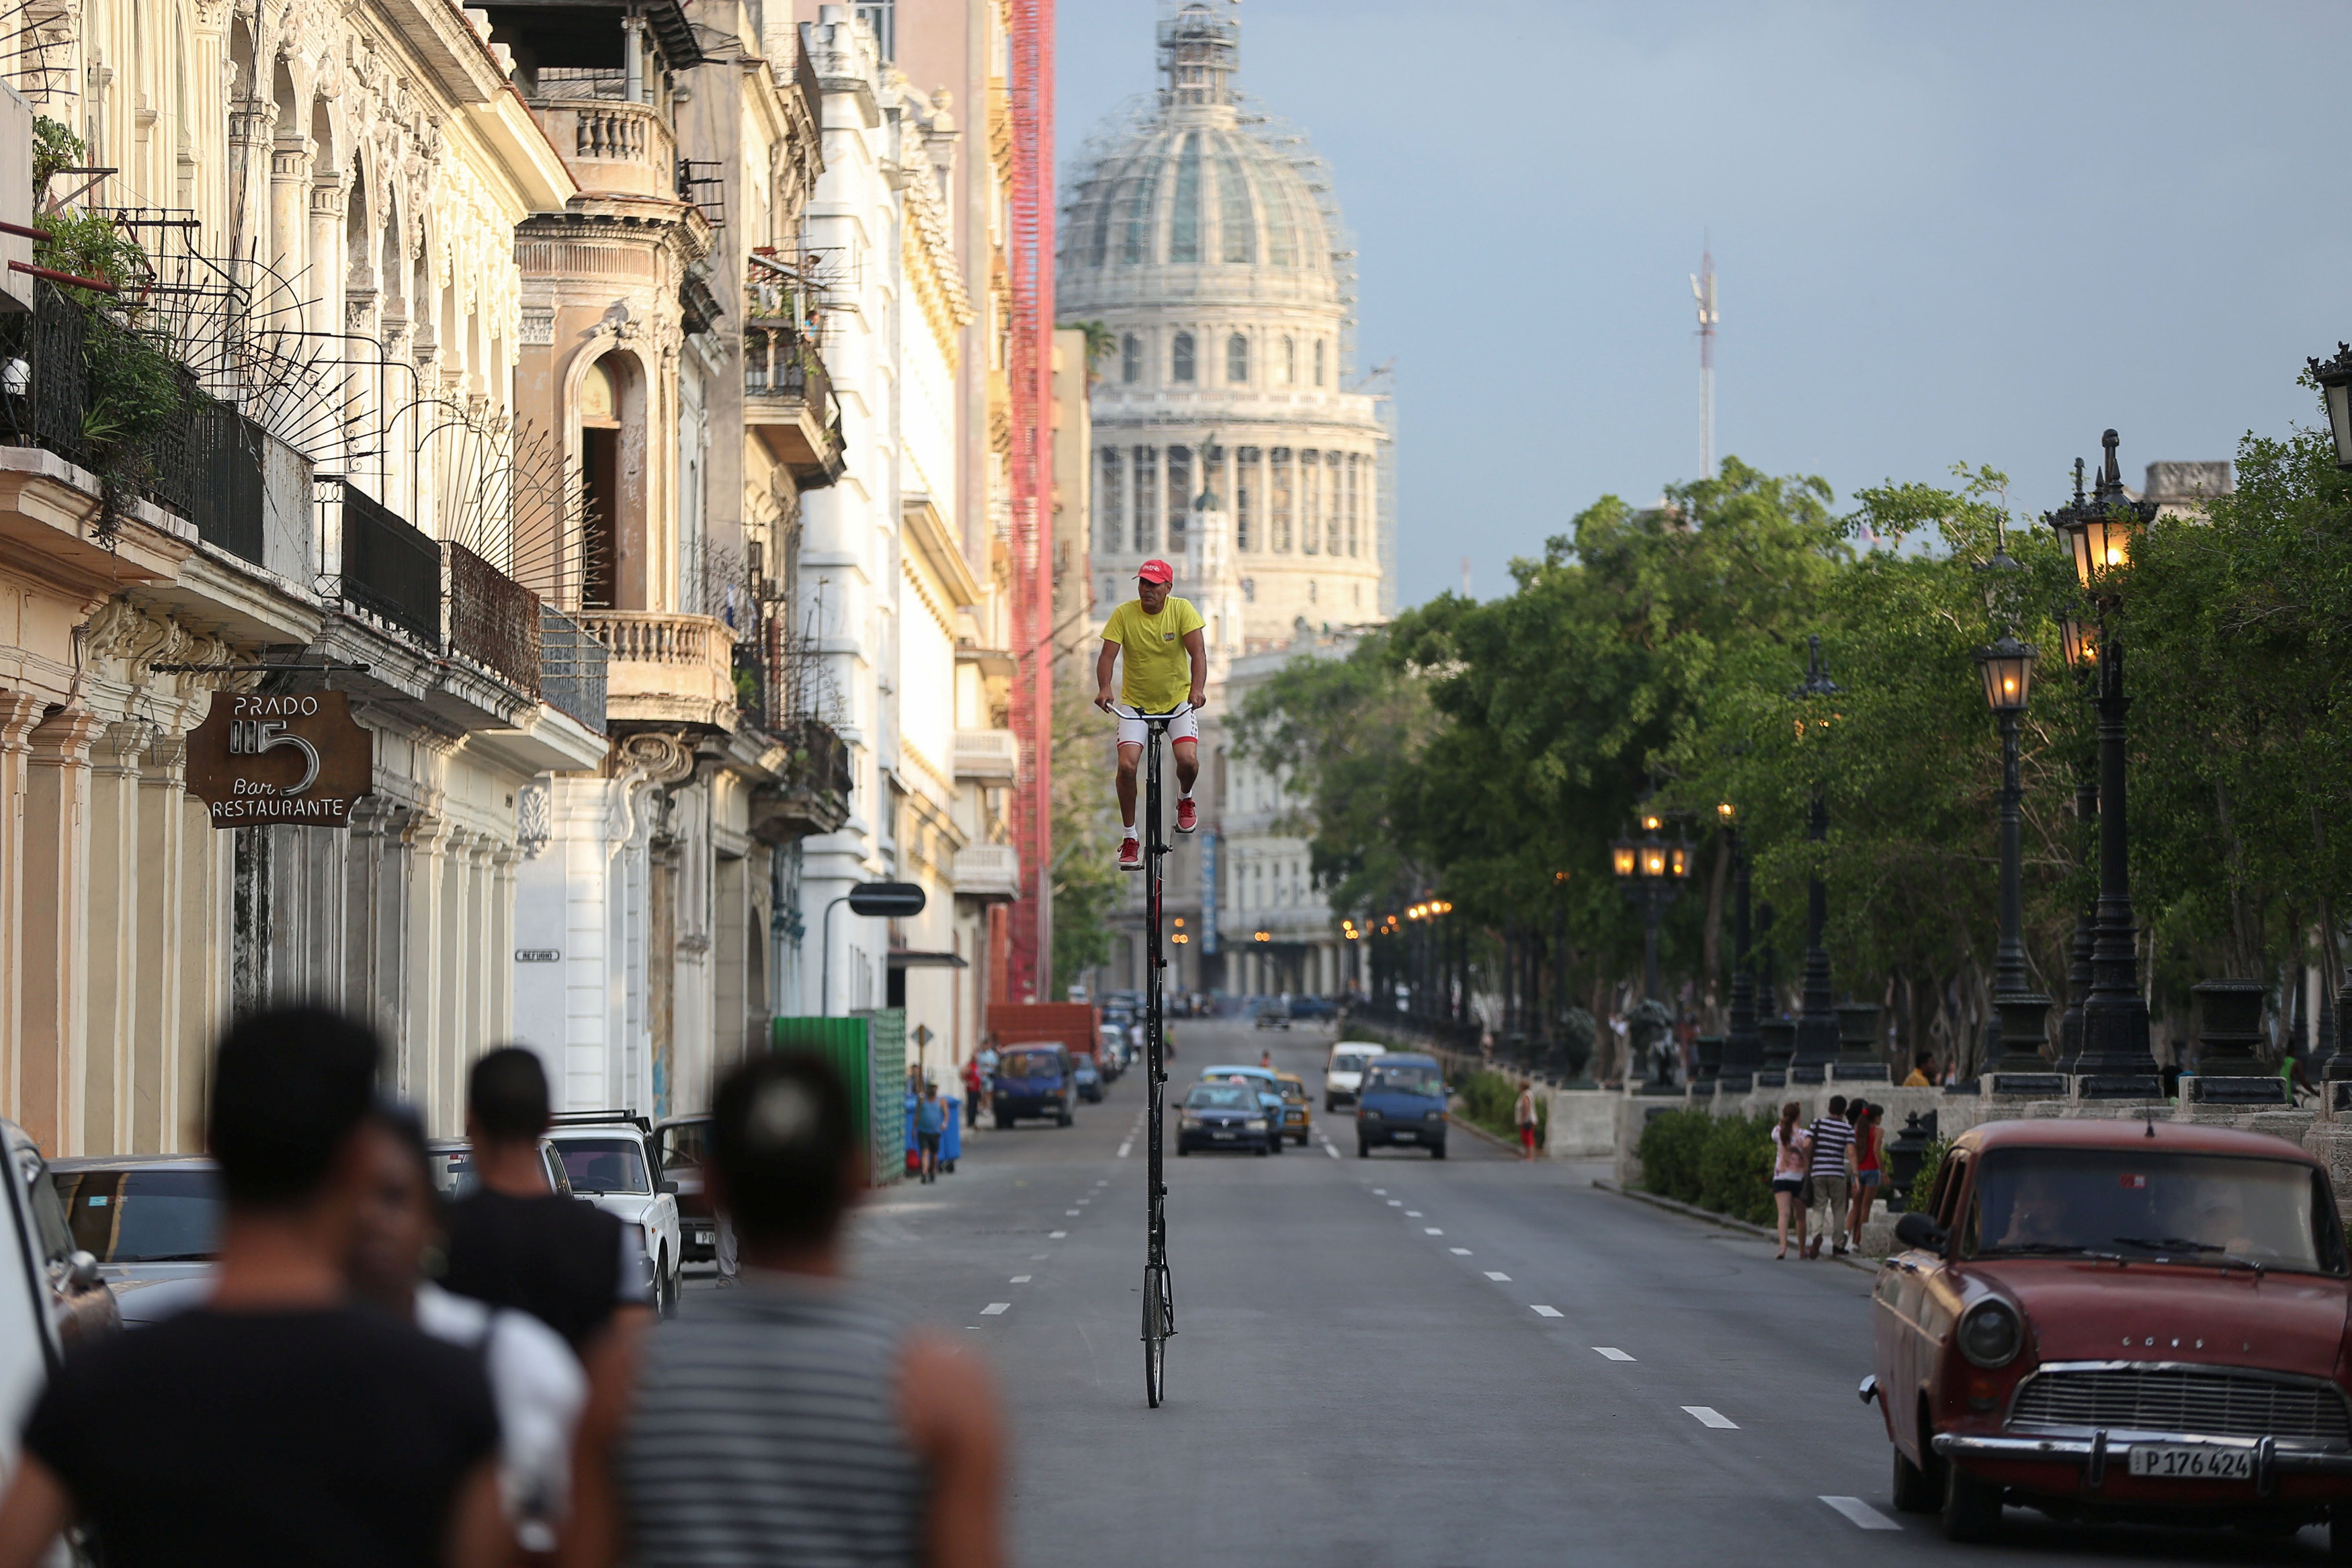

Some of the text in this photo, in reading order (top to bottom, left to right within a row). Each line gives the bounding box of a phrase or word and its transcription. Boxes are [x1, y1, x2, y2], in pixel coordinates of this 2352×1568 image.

[235, 697, 318, 715] PRADO
[230, 720, 321, 797] 115
[233, 778, 276, 795] Bar
[212, 798, 344, 818] RESTAURANTE
